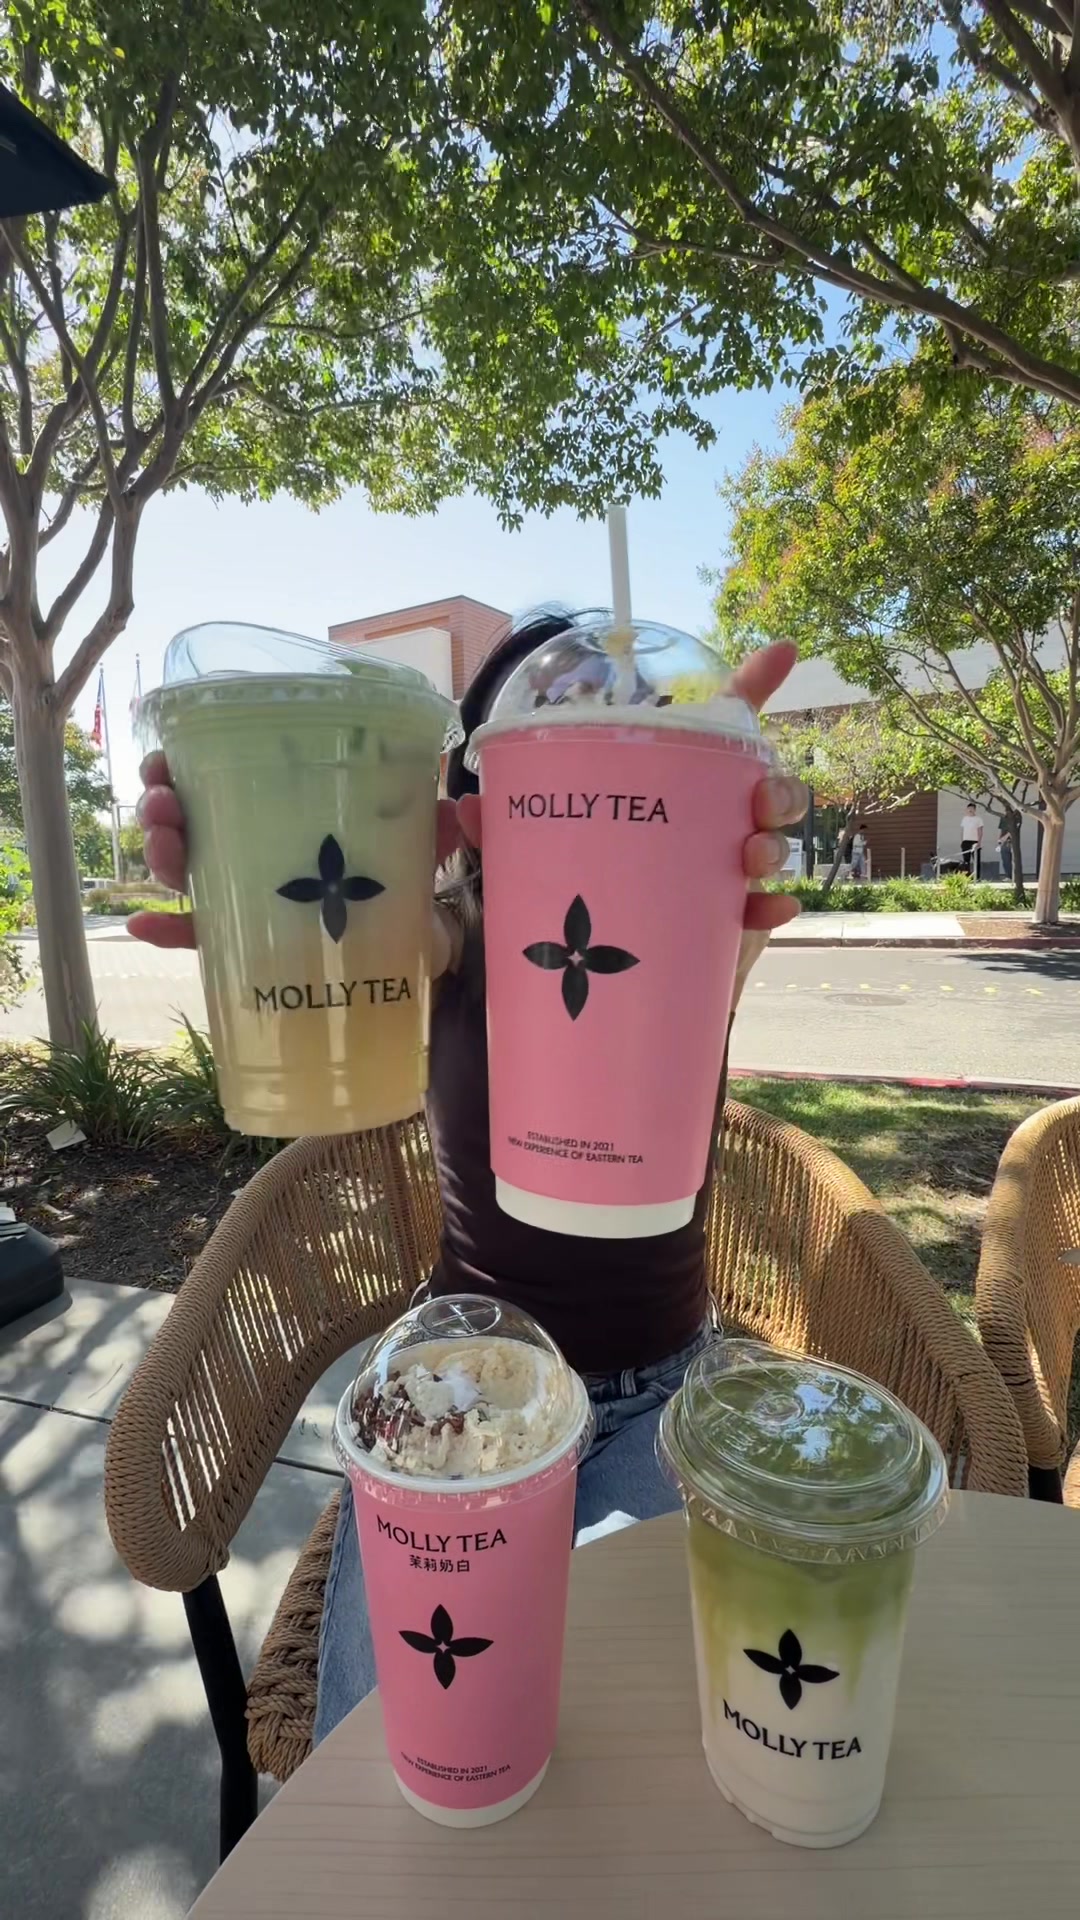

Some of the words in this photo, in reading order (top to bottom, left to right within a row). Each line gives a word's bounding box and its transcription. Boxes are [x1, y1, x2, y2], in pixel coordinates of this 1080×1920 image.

[508, 793, 599, 819] MOLLY
[607, 795, 669, 823] TEA
[253, 981, 357, 1012] MOLLY
[363, 977, 411, 1004] TEA
[580, 1140, 591, 1150] IN
[593, 1142, 614, 1151] 2021
[571, 1150, 583, 1160] OF
[586, 1152, 625, 1164] EASTERN
[628, 1154, 643, 1164] TEA
[376, 1514, 451, 1553] MOLLY
[456, 1528, 507, 1553] TEA
[409, 1554, 470, 1573] 茉莉奶白
[723, 1698, 807, 1758] MOLLY
[813, 1737, 862, 1760] TEA
[466, 1769, 497, 1782] EASTERN
[470, 1765, 487, 1774] 2021
